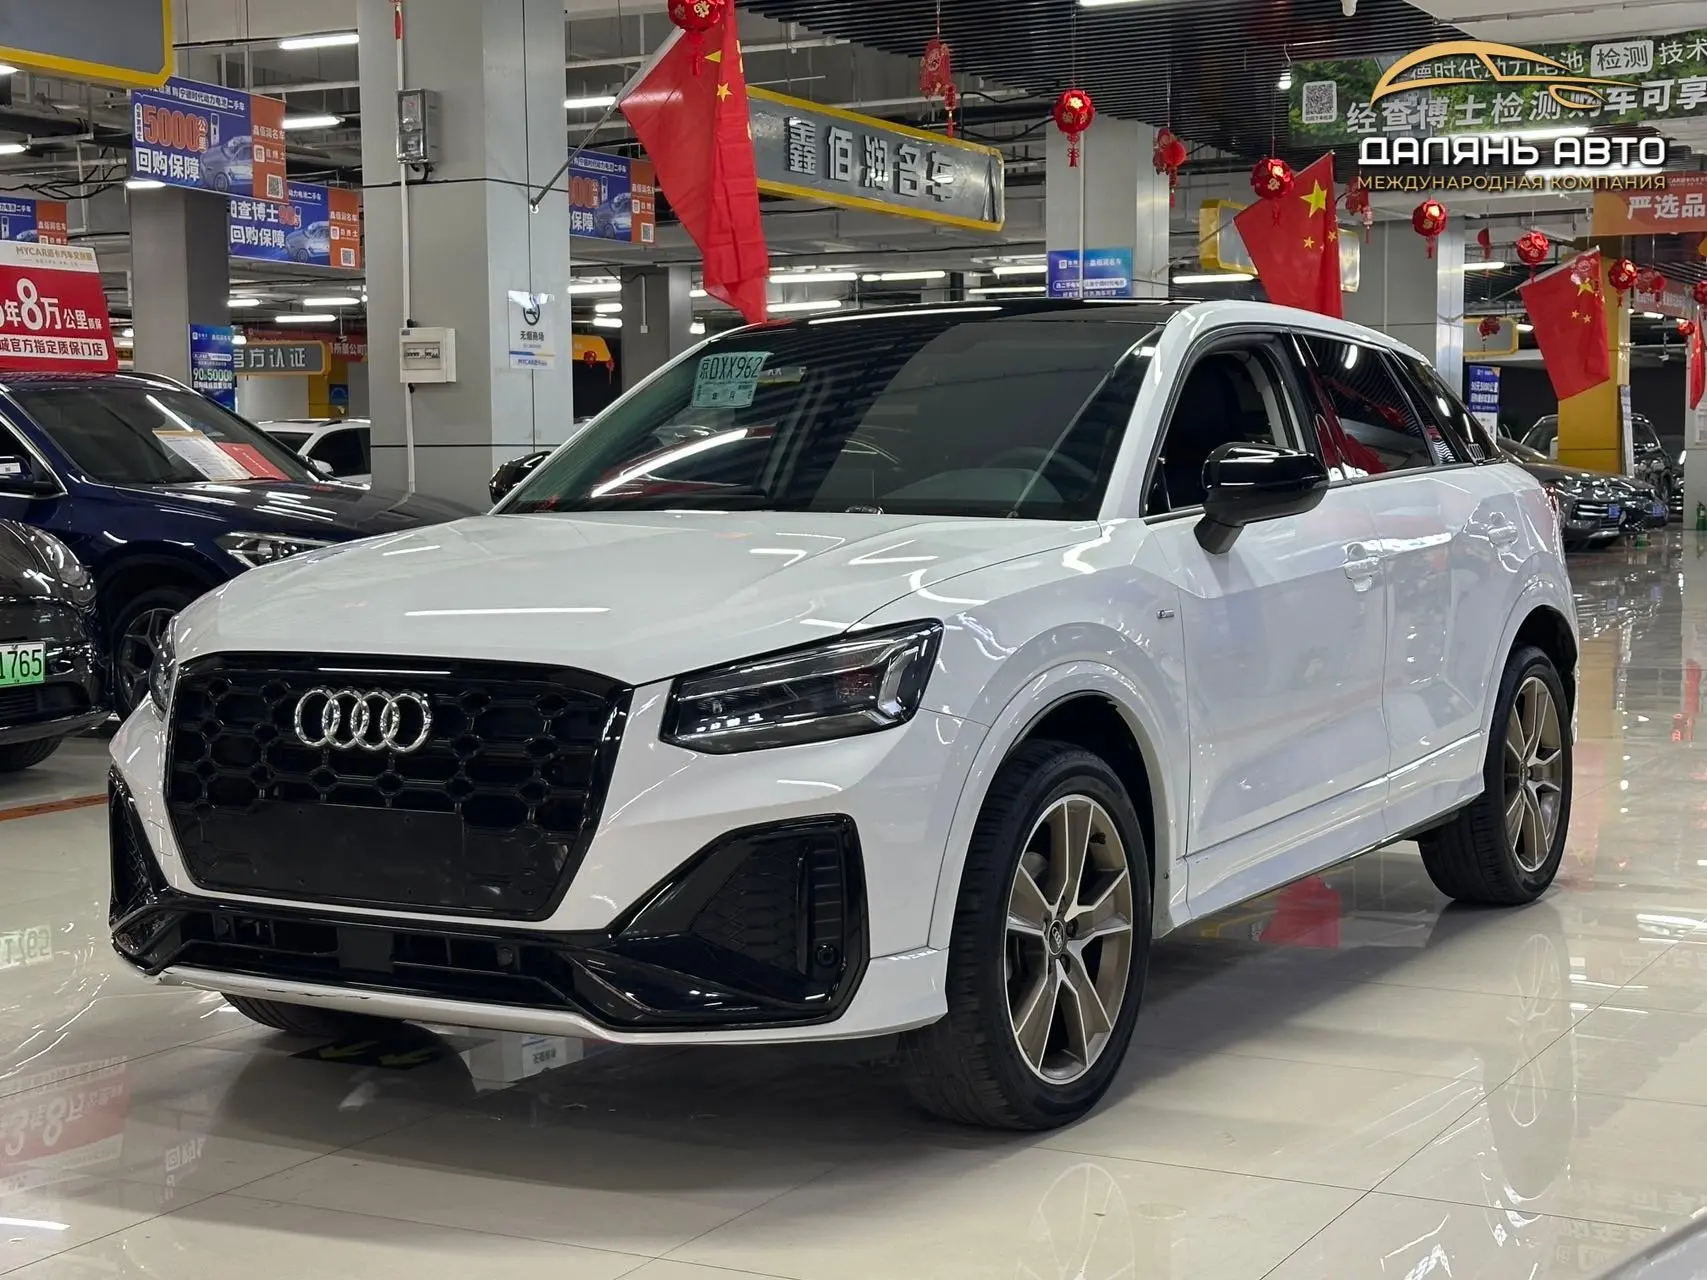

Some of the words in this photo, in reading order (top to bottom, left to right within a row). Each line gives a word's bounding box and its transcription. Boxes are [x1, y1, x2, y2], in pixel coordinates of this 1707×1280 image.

[1596, 45, 1648, 71] 检测
[1659, 38, 1707, 65] 技术
[135, 148, 200, 181] 回购保障
[785, 116, 954, 201] 鑫佰润名车
[230, 225, 285, 248] 回购保障
[233, 347, 306, 369] 官方认证
